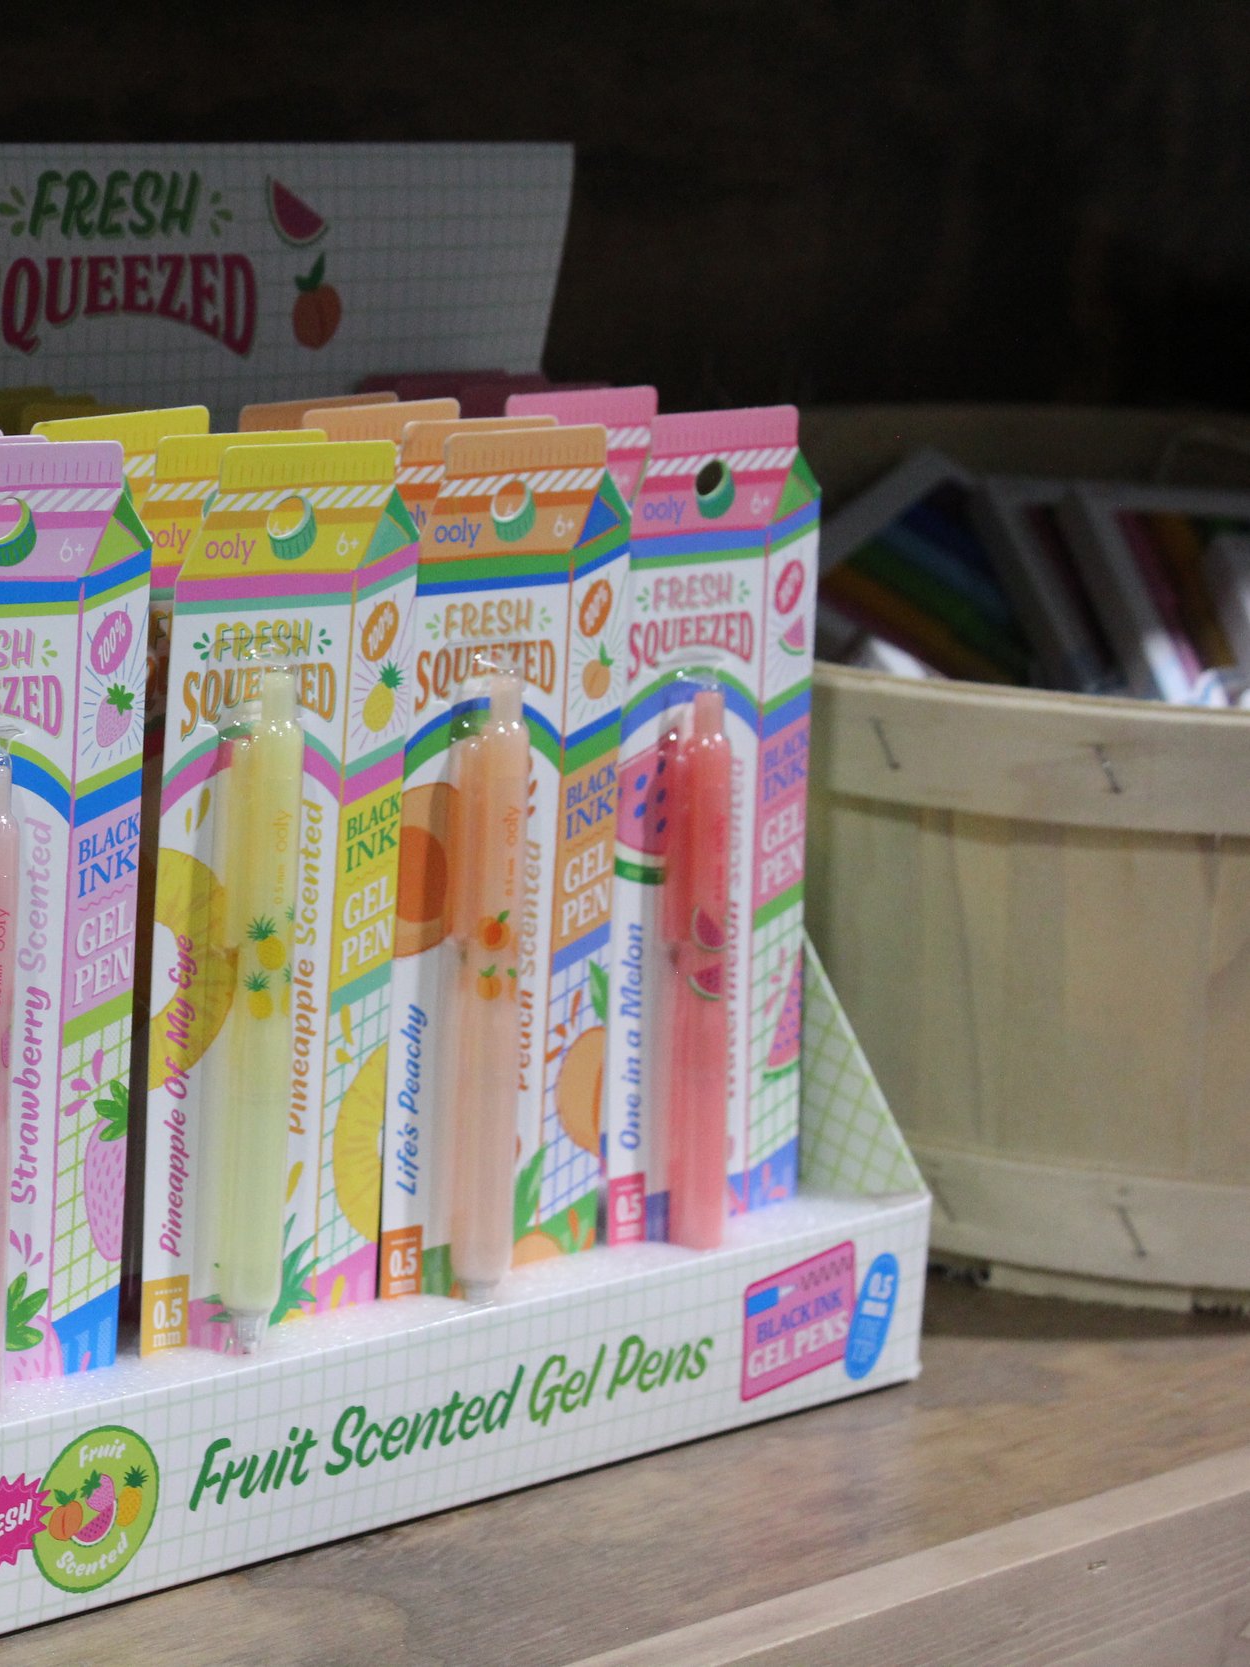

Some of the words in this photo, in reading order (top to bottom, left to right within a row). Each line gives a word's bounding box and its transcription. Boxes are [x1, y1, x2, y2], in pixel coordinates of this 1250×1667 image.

[29, 170, 202, 240] FRESH
[434, 517, 482, 548] ooly
[553, 515, 575, 537] 6+
[643, 497, 686, 525] ooly
[59, 540, 85, 563] 6+
[205, 533, 257, 565] ooly
[336, 532, 360, 556] 6+
[444, 598, 534, 639] FRESH
[653, 573, 733, 612] FRESH
[97, 613, 126, 670] 100%
[213, 618, 312, 662] FRESH
[628, 611, 754, 679] SQUEEZED
[180, 662, 337, 742] SQUEED
[567, 762, 617, 809] BLACK
[78, 812, 140, 865] BLACK
[345, 791, 402, 842] BLACK
[565, 791, 614, 840] INK
[77, 843, 138, 898] INK
[294, 800, 324, 946] Scented
[345, 820, 398, 873] INK
[564, 841, 611, 893] GEL
[17, 816, 54, 974] Scented
[342, 875, 395, 930] GEL
[561, 877, 611, 937] PEN
[74, 901, 134, 959] GEL
[340, 914, 393, 976] PEN
[73, 943, 133, 1007] PEN
[168, 934, 199, 990] Eye
[620, 922, 644, 1018] Melon
[166, 997, 196, 1050] My
[627, 1029, 642, 1049] a
[163, 1056, 191, 1100] Of
[397, 1003, 428, 1115] Peachy
[621, 1055, 642, 1085] in
[11, 985, 52, 1205] Strawberry
[619, 1090, 642, 1150] One
[159, 1108, 190, 1258] Pineapple
[397, 1123, 419, 1197] Life's
[152, 1330, 181, 1348] mm
[153, 1299, 183, 1330] 0.5
[189, 1426, 319, 1511] Fruit
[324, 1364, 526, 1477] Scented
[528, 1343, 607, 1427] Gel
[607, 1334, 714, 1401] Pens
[55, 1531, 129, 1577] Scented
